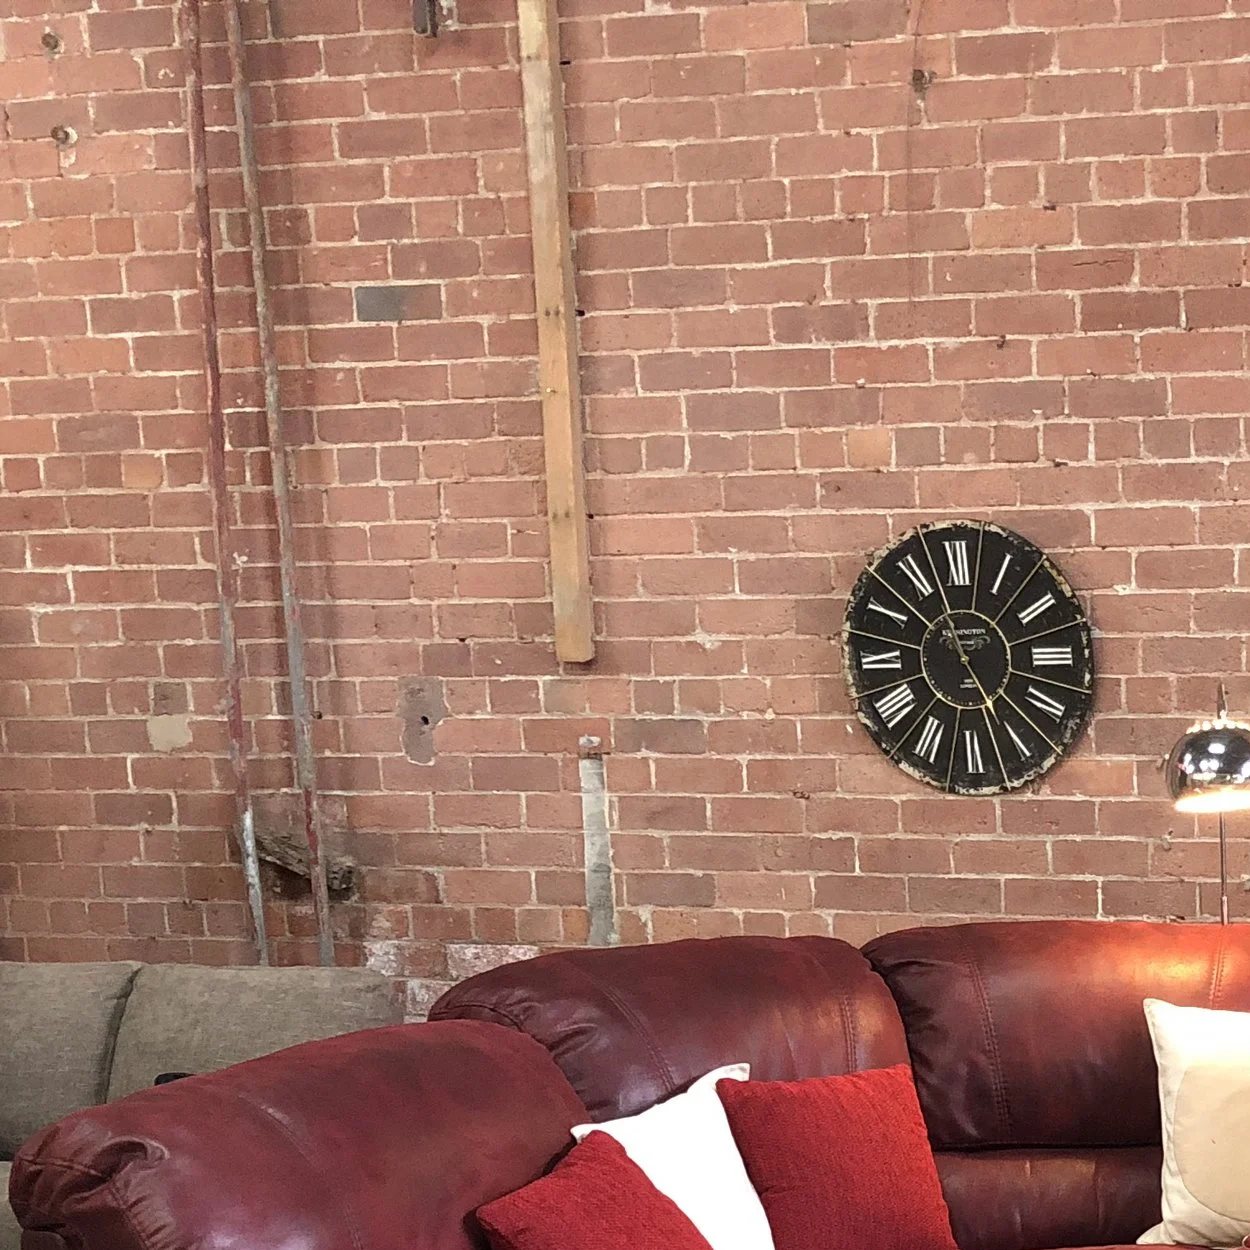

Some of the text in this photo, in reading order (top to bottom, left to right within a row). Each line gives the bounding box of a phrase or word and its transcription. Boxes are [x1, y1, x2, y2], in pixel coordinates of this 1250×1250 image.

[896, 554, 935, 601] XI
[942, 541, 971, 586] XII
[990, 553, 1013, 595] I
[866, 596, 908, 629] X
[1017, 592, 1056, 627] II
[859, 650, 902, 671] IX
[1031, 646, 1073, 667] III
[873, 683, 918, 730] VIII
[912, 715, 945, 764] VII
[1003, 720, 1032, 762] V
